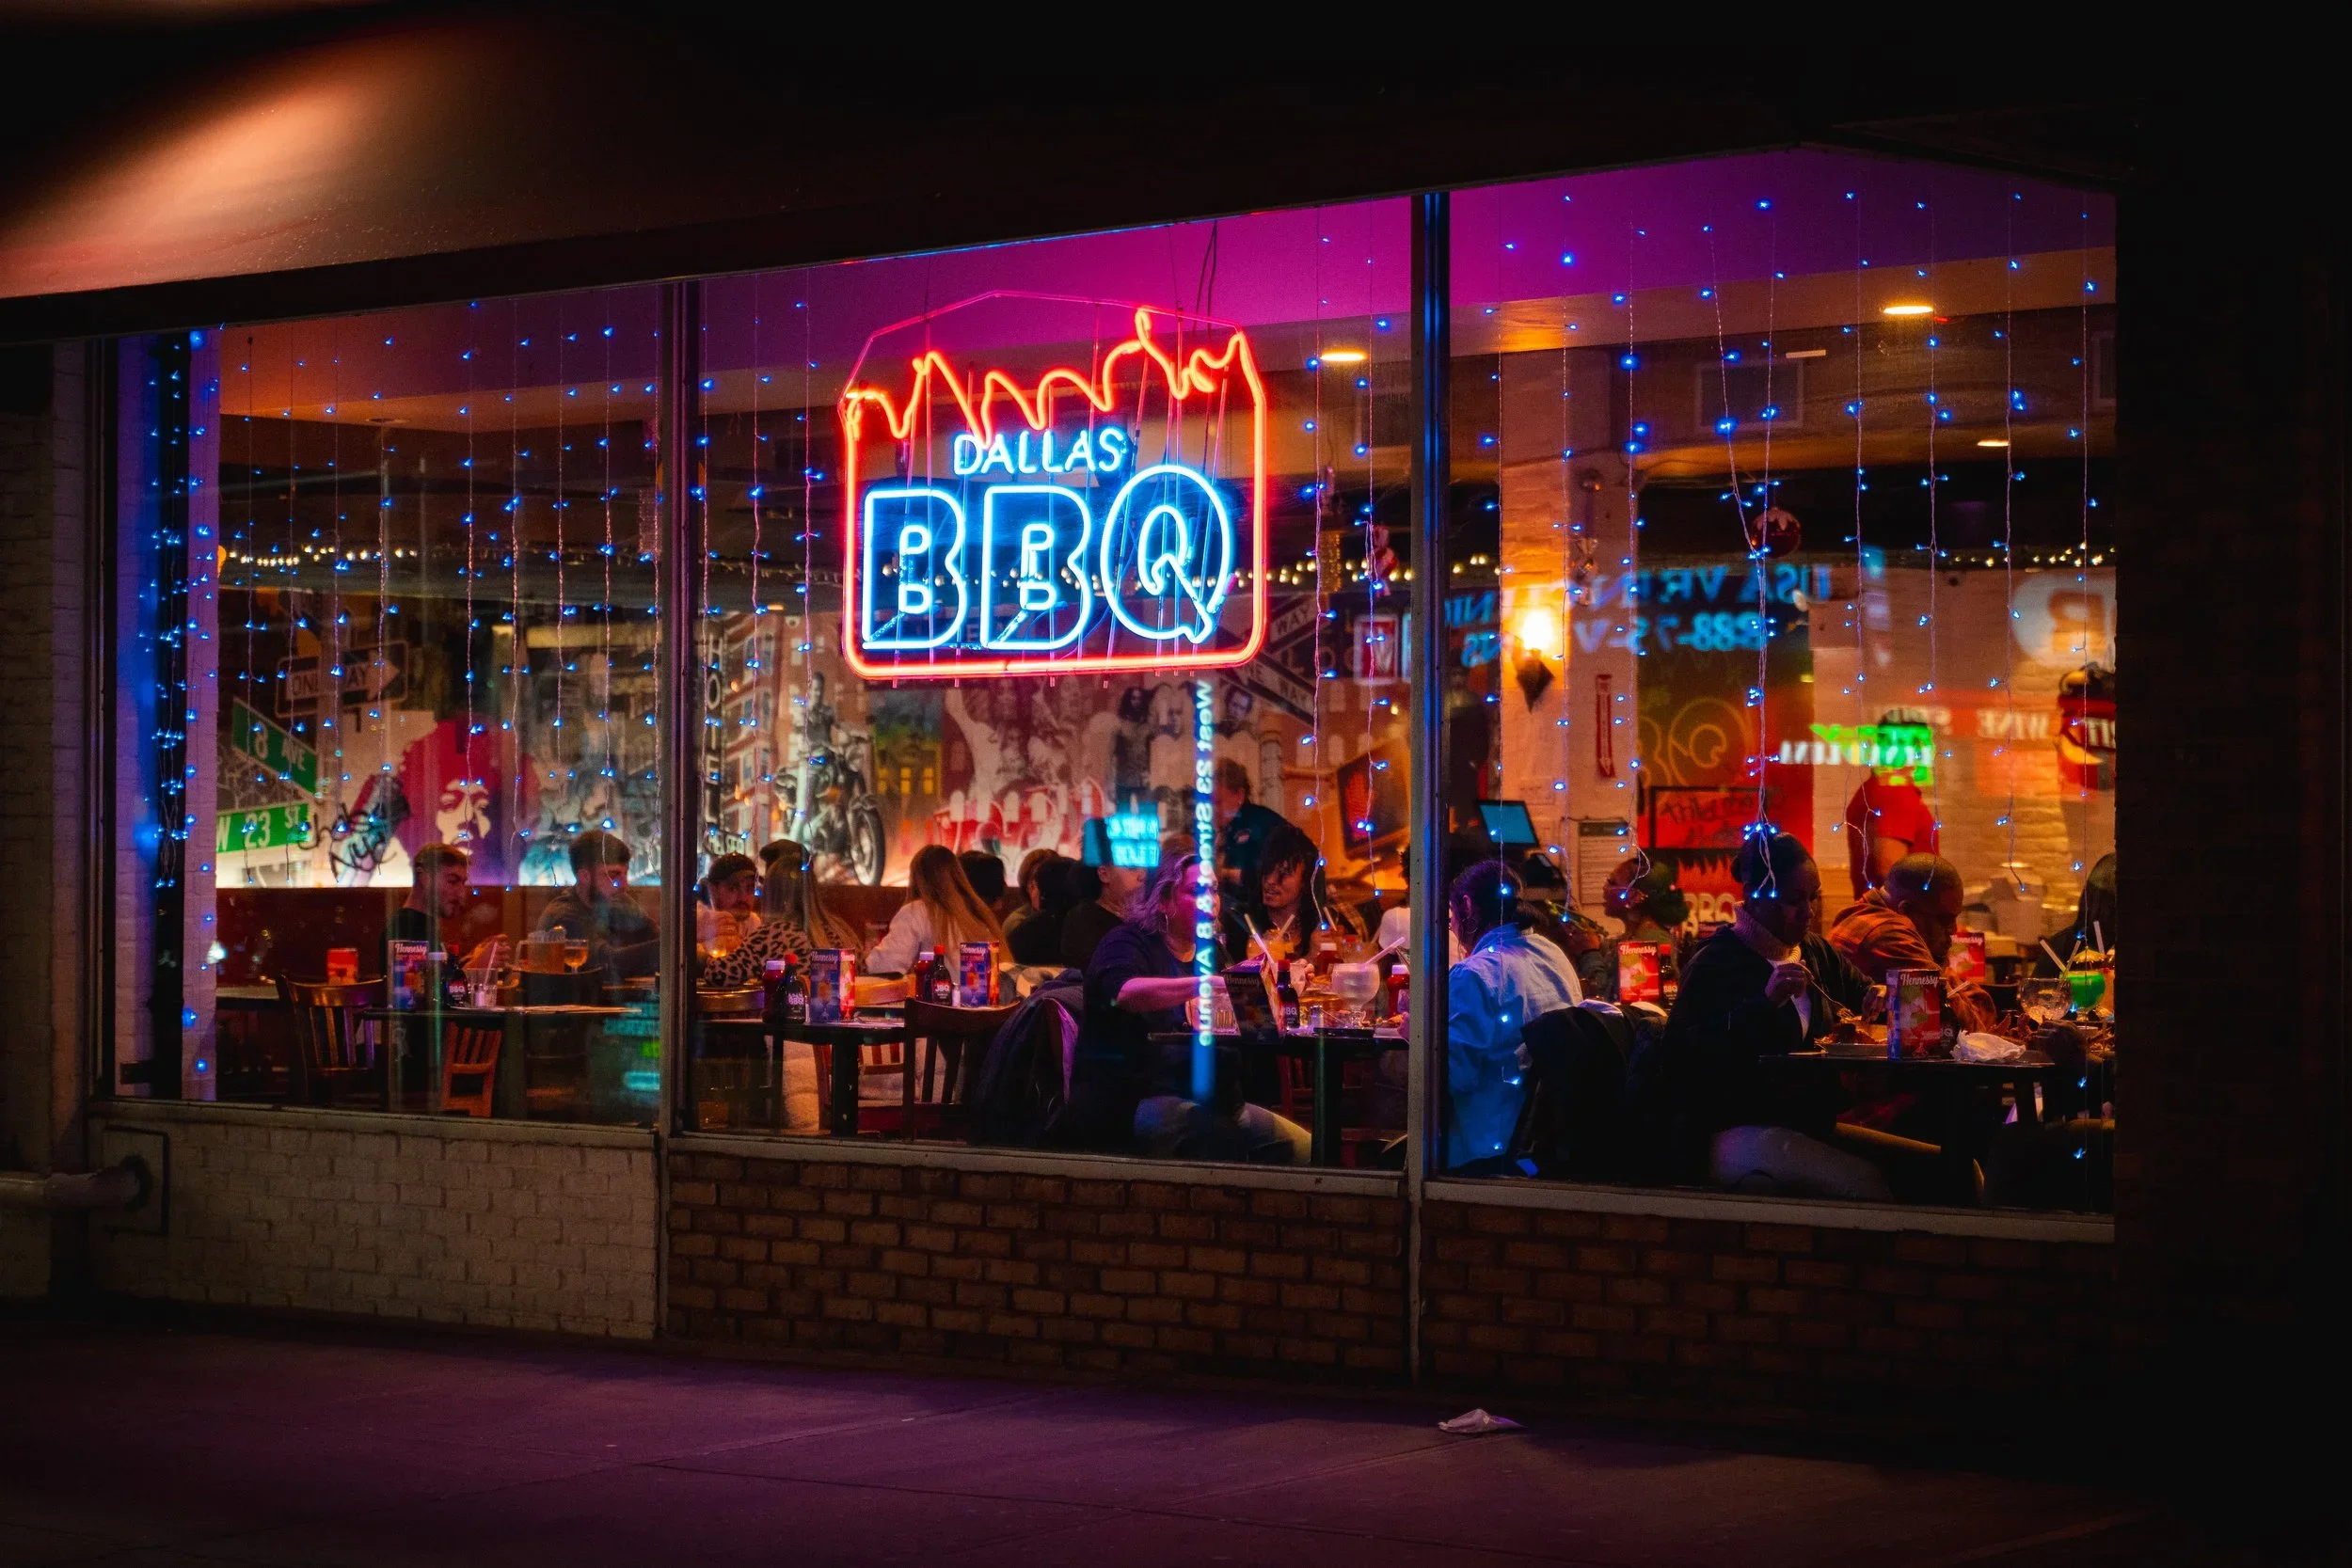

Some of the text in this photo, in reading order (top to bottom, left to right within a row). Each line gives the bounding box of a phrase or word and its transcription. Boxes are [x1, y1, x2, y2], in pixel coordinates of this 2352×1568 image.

[953, 426, 1128, 477] DALLAS
[861, 464, 1233, 651] BBQ
[253, 723, 307, 772] 8 AVE
[243, 810, 271, 849] 23
[285, 808, 300, 830] ST
[394, 942, 428, 956] Hennessy
[810, 950, 838, 964] Hennessy
[1619, 944, 1657, 957] Hennessy
[1224, 973, 1261, 987] Hennessy
[1899, 972, 1939, 989] Hennessy
